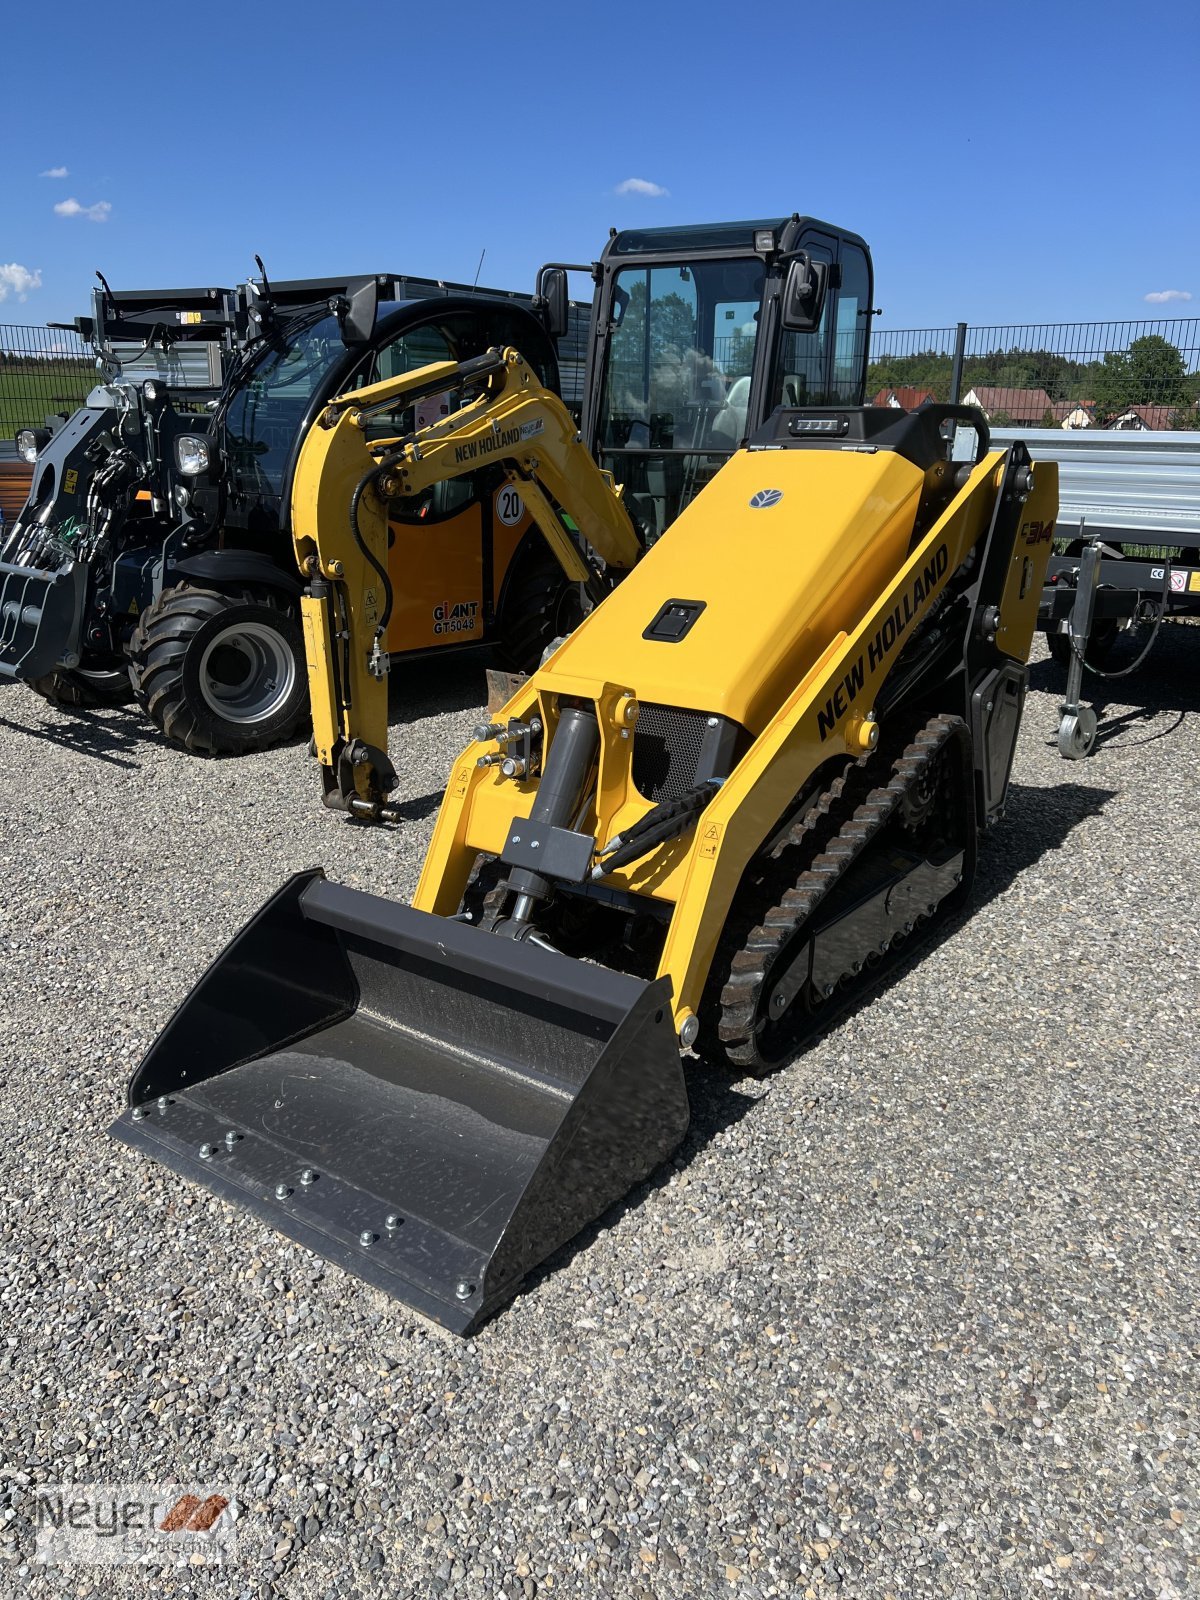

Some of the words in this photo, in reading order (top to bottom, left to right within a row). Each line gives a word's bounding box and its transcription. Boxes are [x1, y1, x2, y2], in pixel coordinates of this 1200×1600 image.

[454, 442, 477, 463] NEW
[479, 427, 520, 456] HOLLAND
[503, 492, 519, 518] 20
[433, 618, 475, 635] GT5048
[816, 655, 865, 742] NEW
[867, 543, 949, 674] HOLLAND
